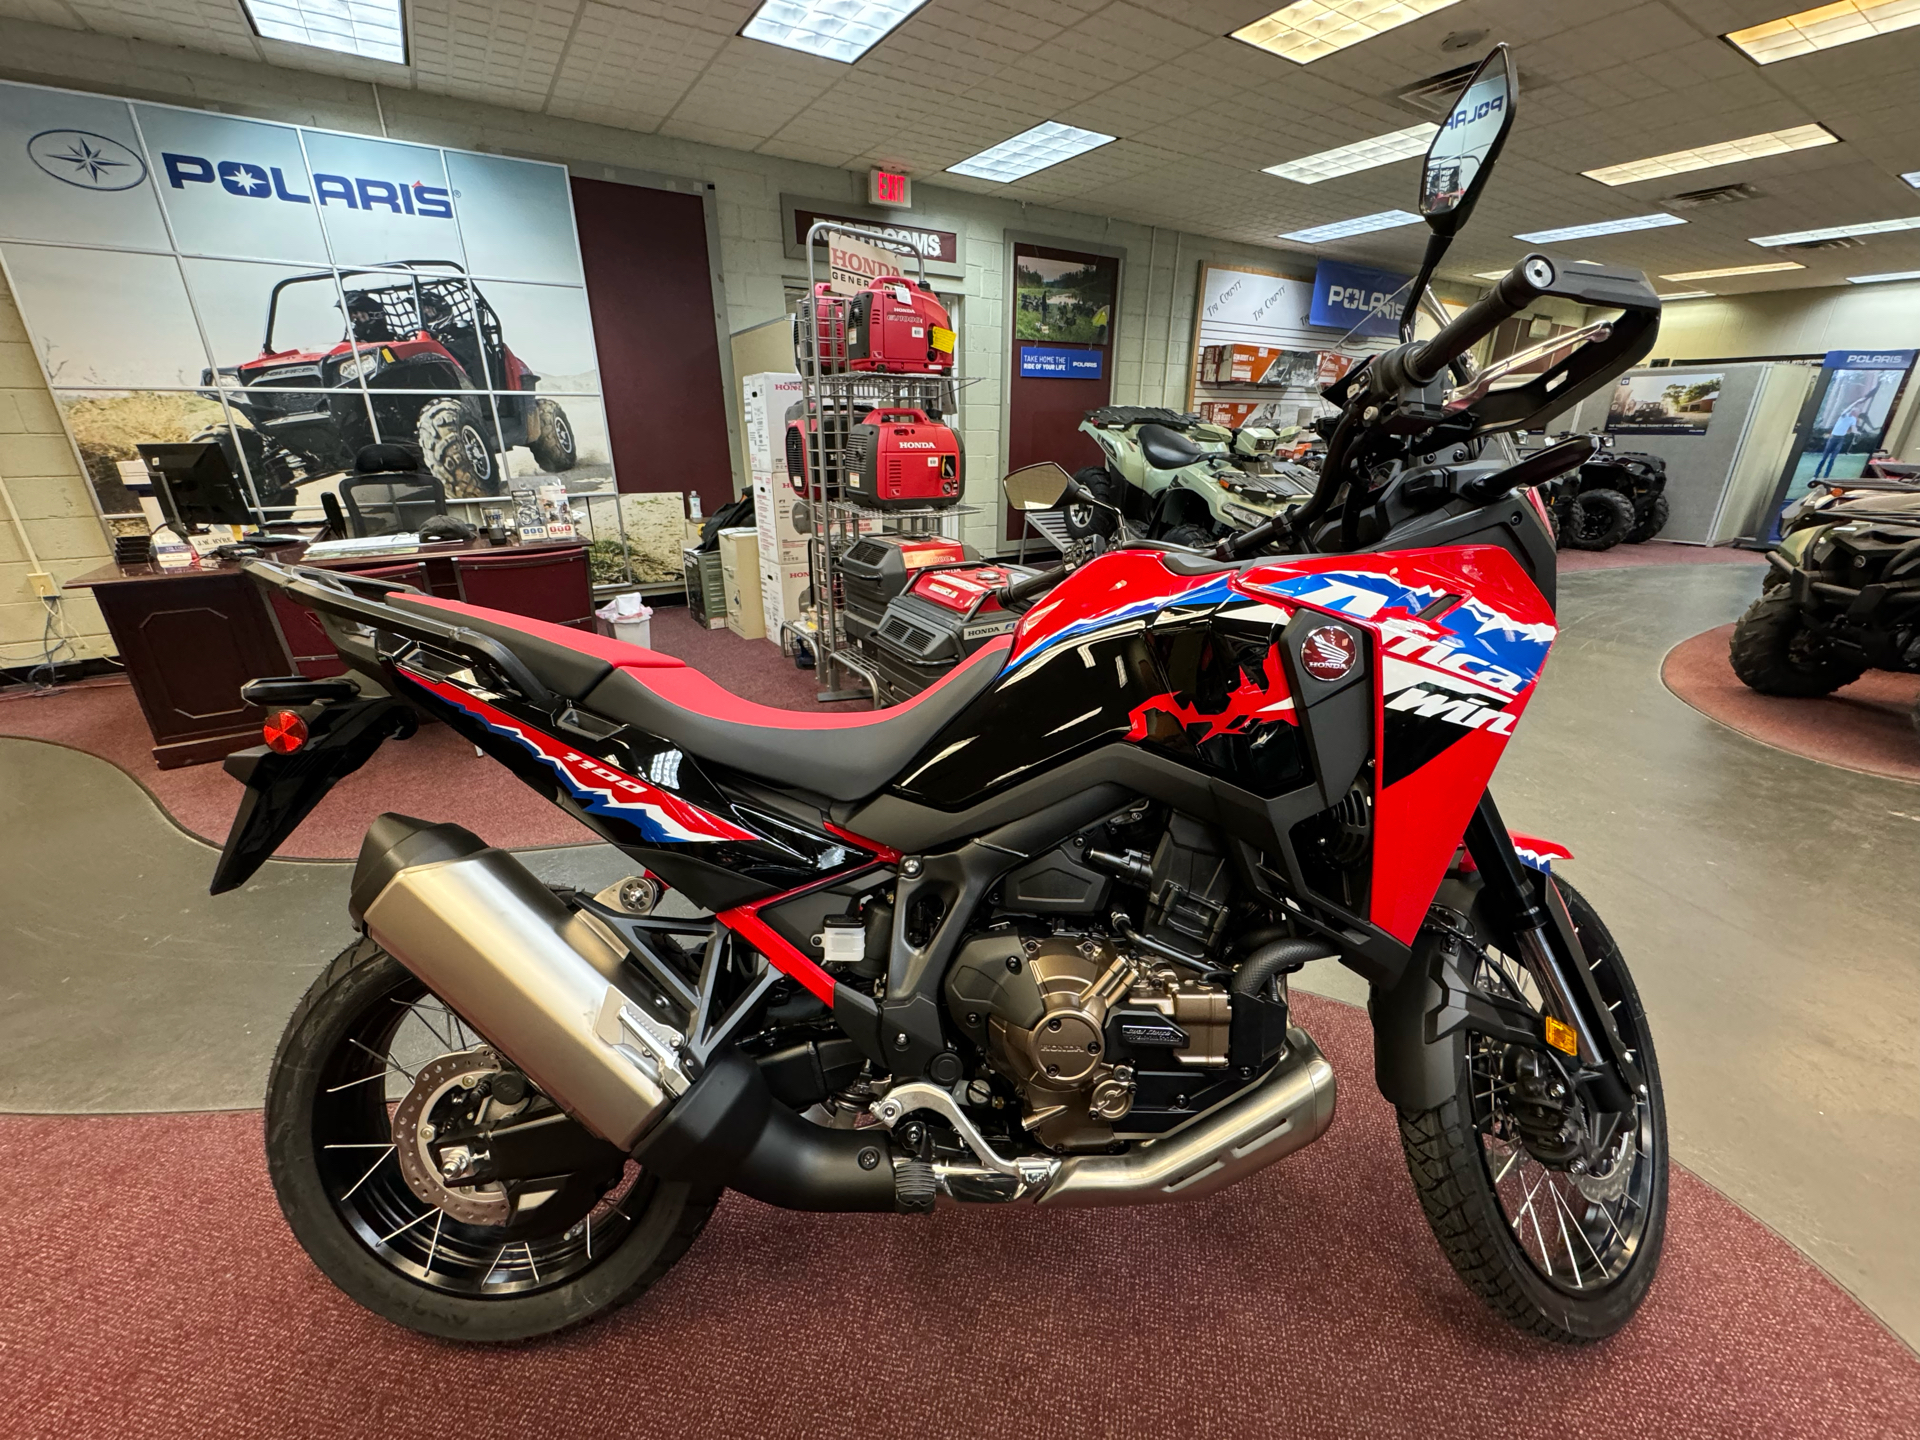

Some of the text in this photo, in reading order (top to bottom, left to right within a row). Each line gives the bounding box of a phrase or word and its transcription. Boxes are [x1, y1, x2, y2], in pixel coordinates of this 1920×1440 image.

[161, 152, 454, 219] POLARIS
[878, 171, 906, 203] EXIT
[813, 217, 942, 257] RTROOMS
[831, 247, 900, 277] HONDA
[1024, 355, 1066, 364] TAKE HOME THE
[1846, 354, 1903, 364] POLARIS
[899, 441, 936, 449] HONDA
[967, 626, 1000, 637] HONDA
[1308, 661, 1348, 670] HONDA
[562, 752, 648, 794] 1100
[1040, 1044, 1085, 1053] HONDA
